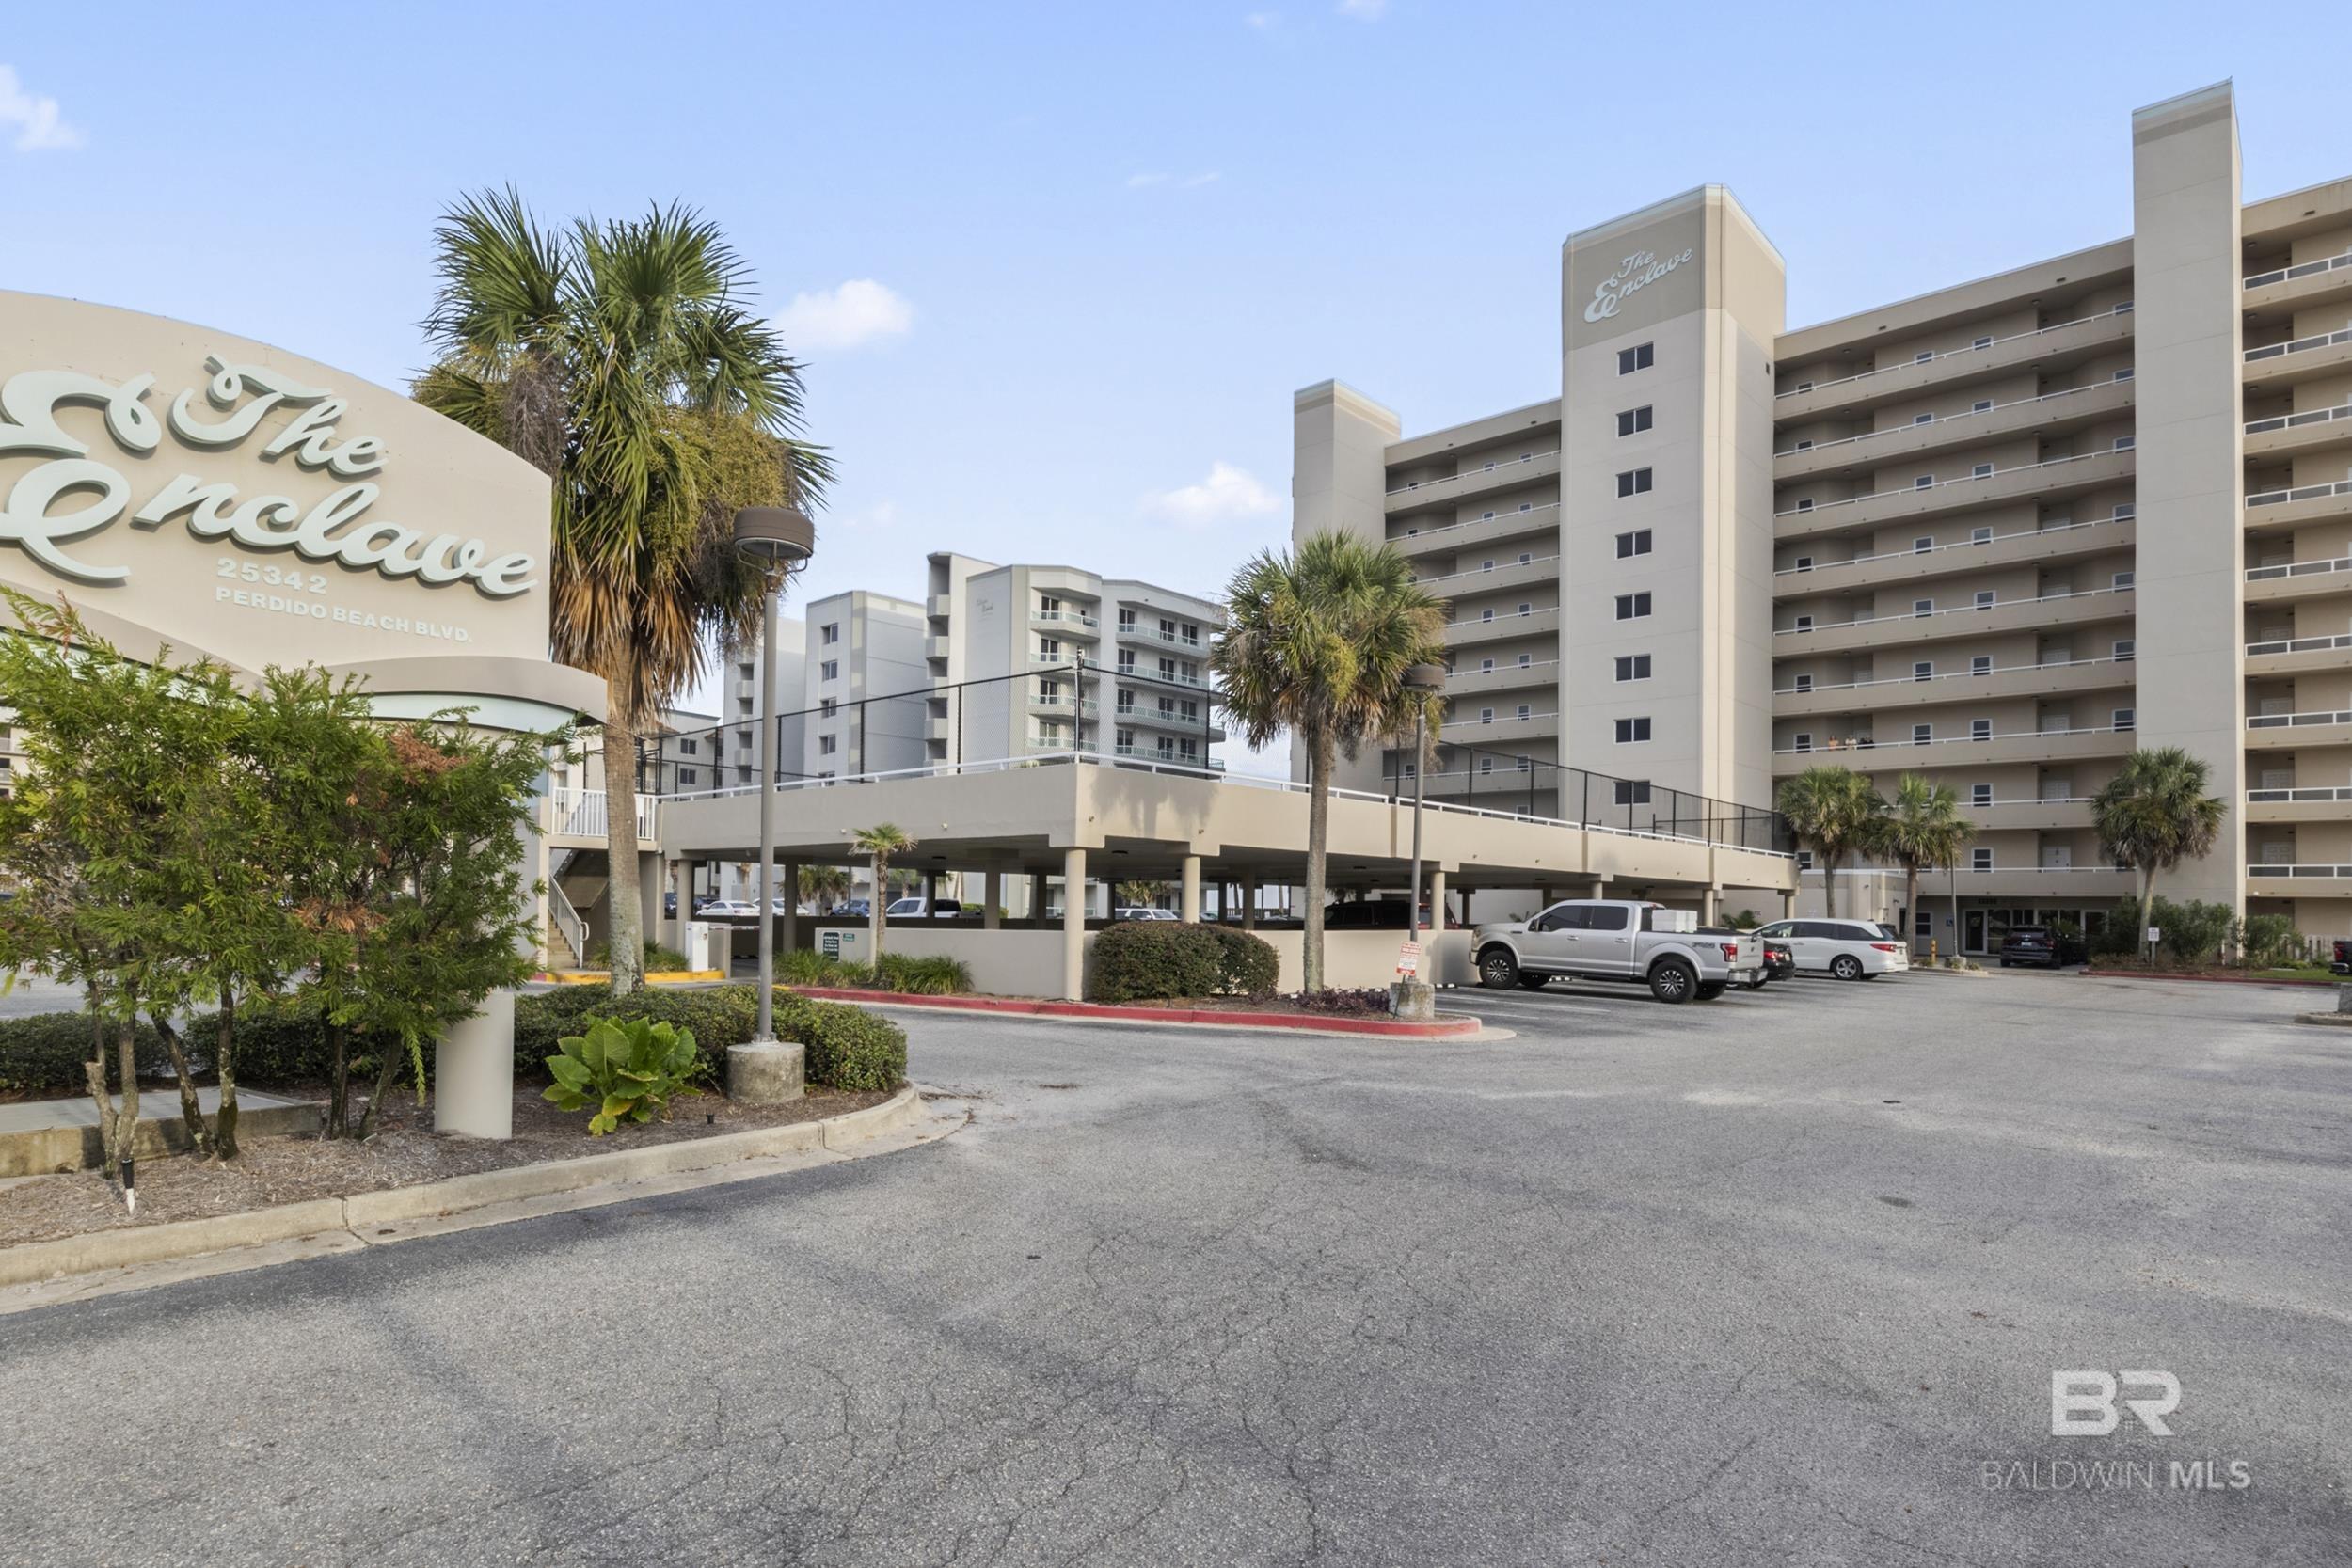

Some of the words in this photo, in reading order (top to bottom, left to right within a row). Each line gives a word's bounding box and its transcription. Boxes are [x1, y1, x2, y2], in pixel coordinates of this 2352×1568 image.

[1584, 248, 1693, 323] Enclave
[1618, 250, 1656, 279] The
[168, 354, 388, 475] The
[0, 369, 539, 596] Enclave
[217, 557, 327, 595] 25342
[215, 586, 328, 620] PERDIDO
[332, 606, 409, 633] BEACH
[414, 620, 473, 643] BLVD.
